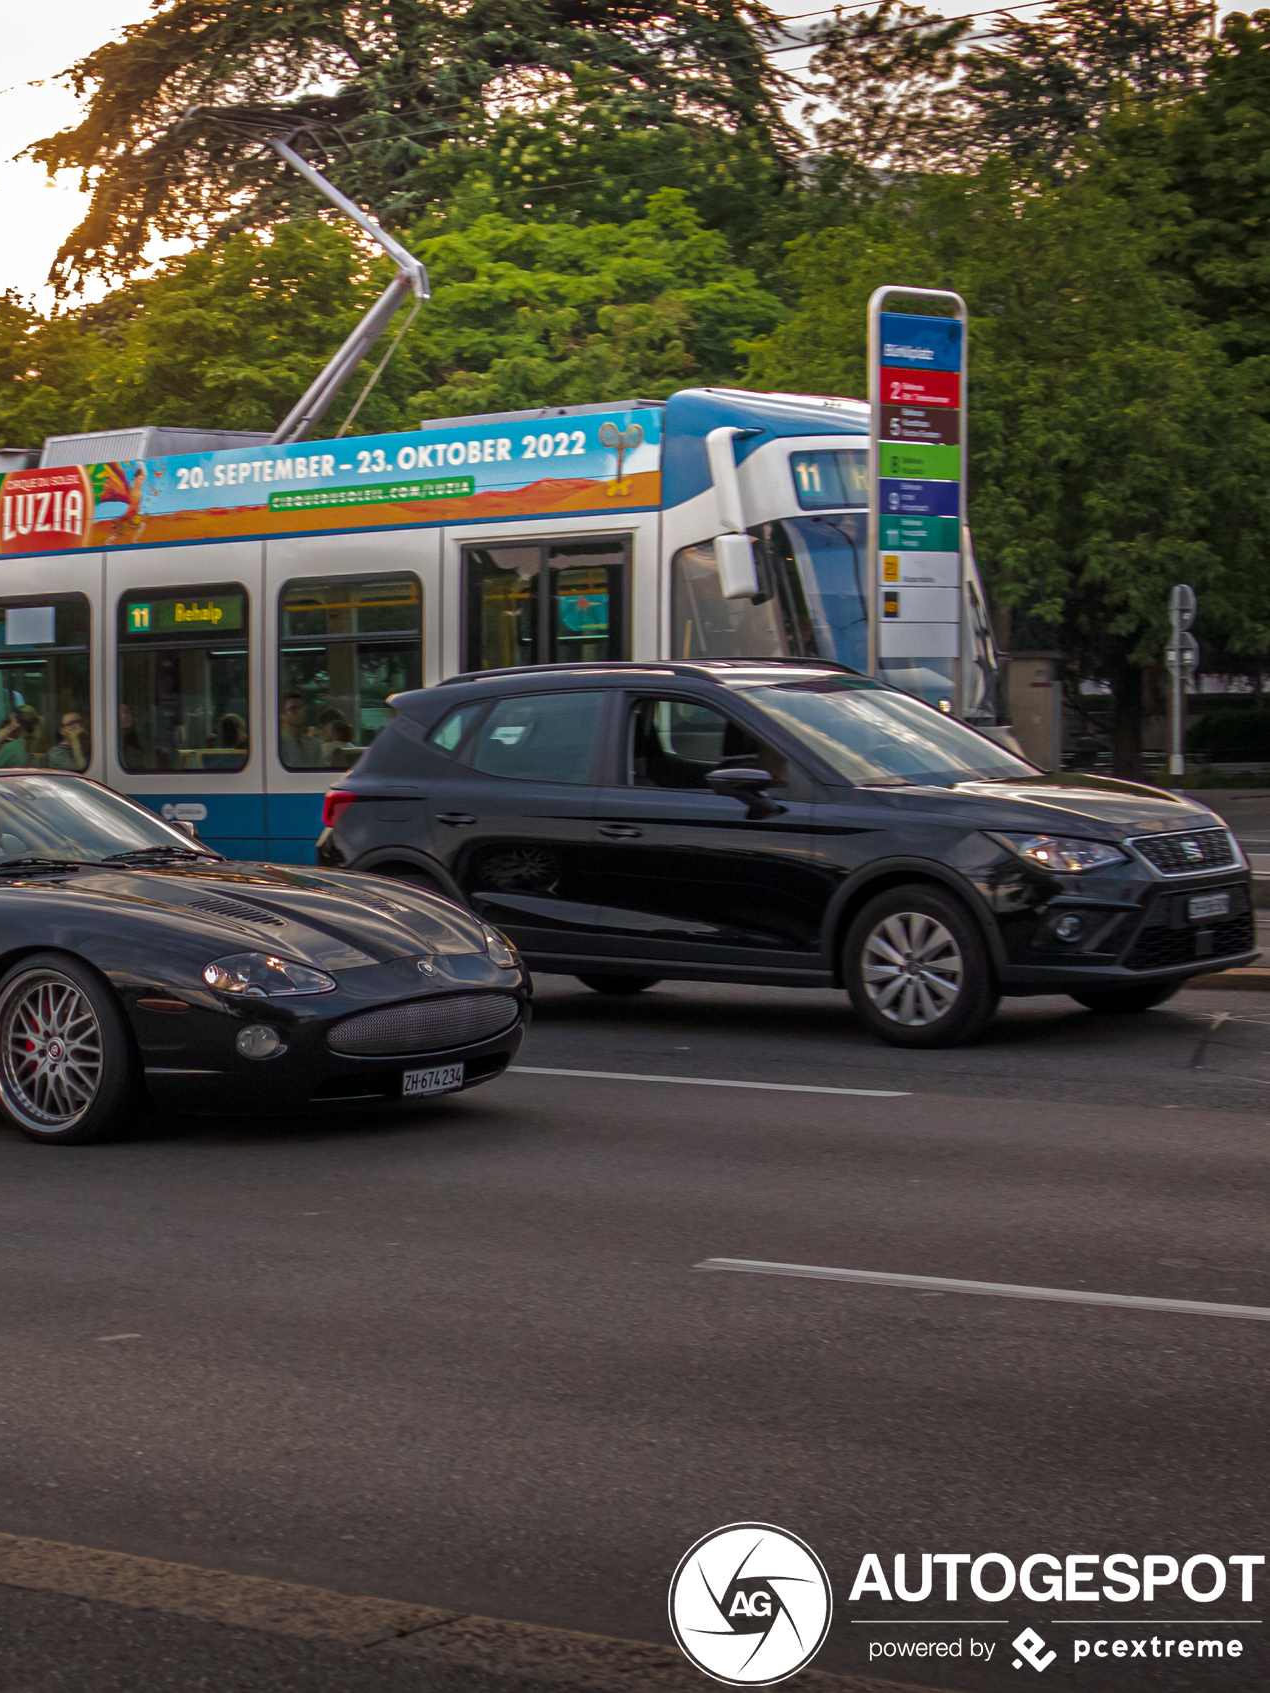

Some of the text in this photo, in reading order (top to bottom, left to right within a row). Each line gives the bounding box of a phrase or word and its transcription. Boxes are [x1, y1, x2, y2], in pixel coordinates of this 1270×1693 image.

[890, 381, 902, 400] 2
[890, 417, 902, 436] 5
[176, 467, 209, 490] 20.
[214, 455, 335, 486] SEPTEMBER
[358, 449, 394, 475] 23.
[397, 438, 513, 470] OKTOBER
[520, 430, 587, 459] 2022
[795, 461, 822, 492] 11
[3, 490, 83, 541] LUZIA
[131, 602, 223, 628] 11 Rehalp
